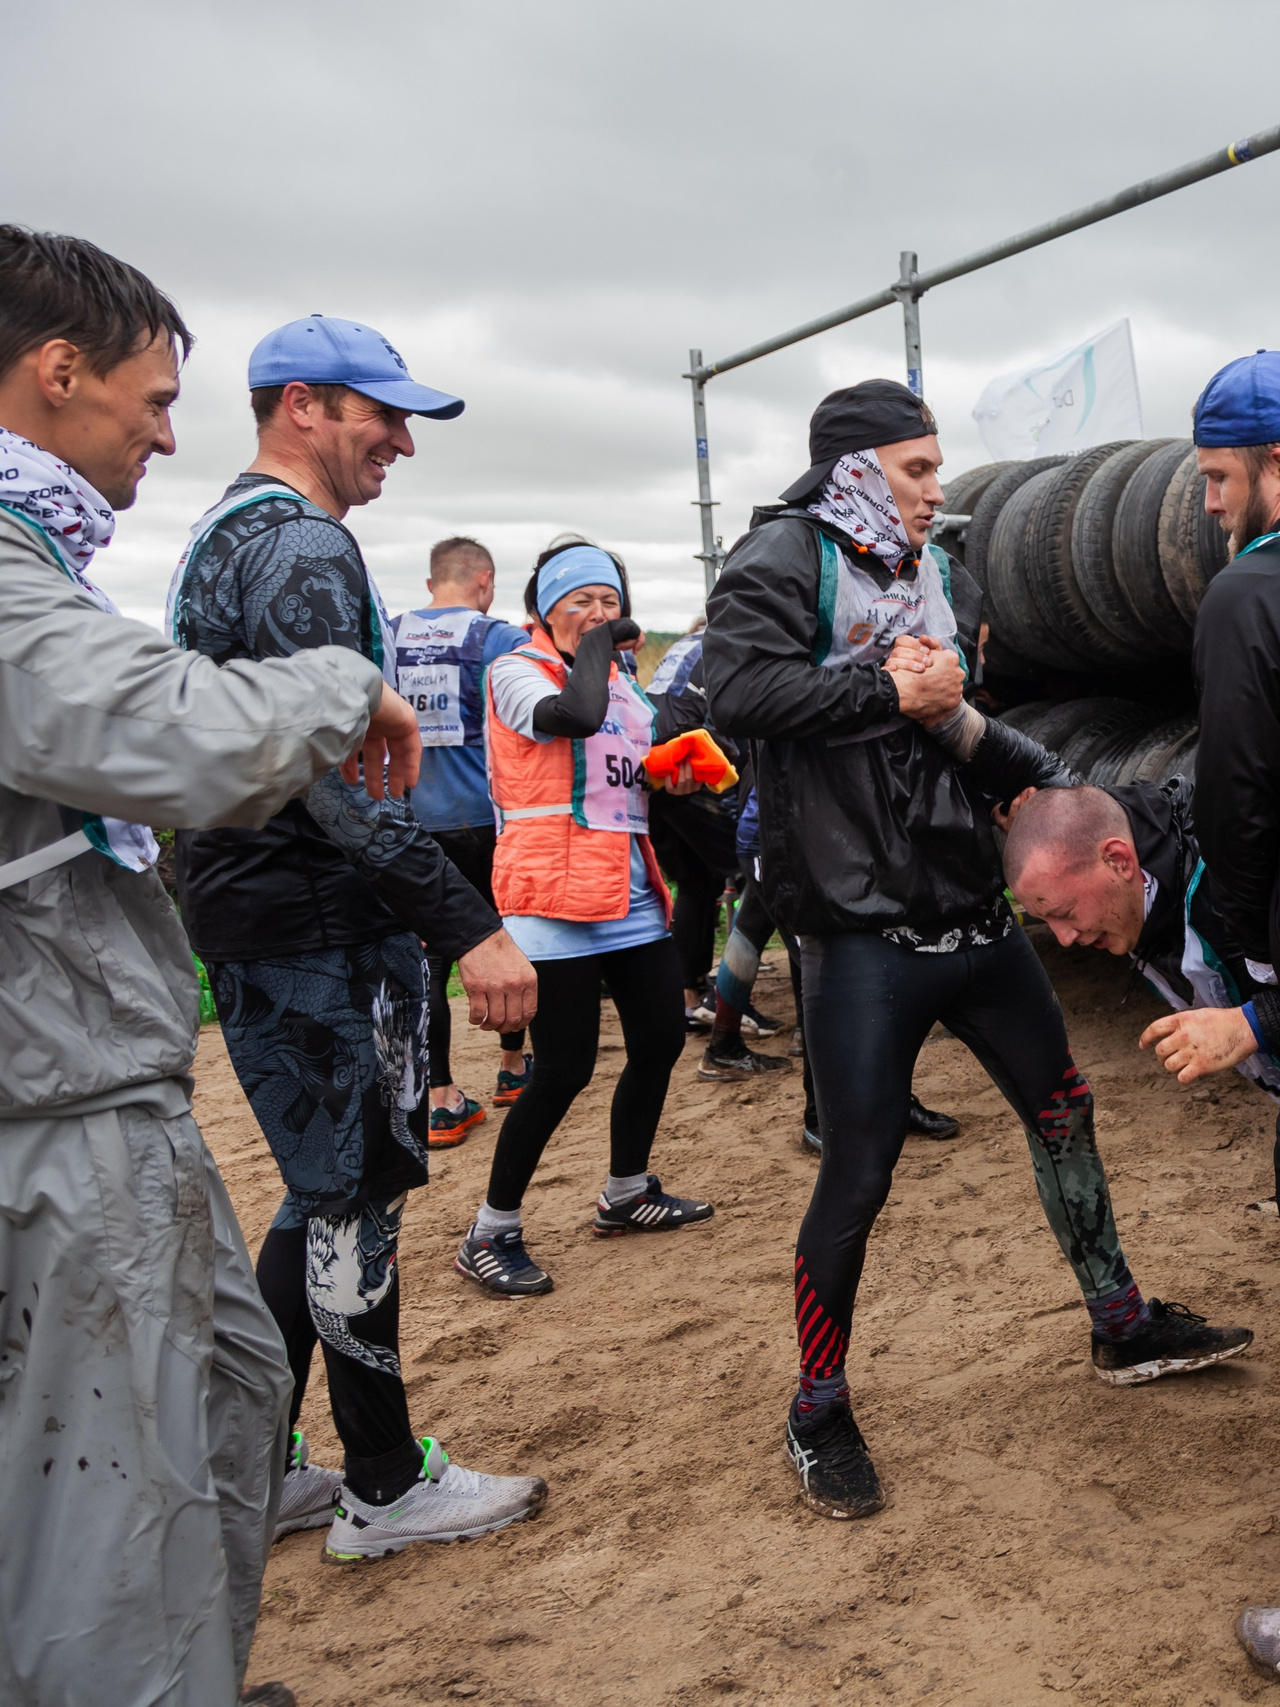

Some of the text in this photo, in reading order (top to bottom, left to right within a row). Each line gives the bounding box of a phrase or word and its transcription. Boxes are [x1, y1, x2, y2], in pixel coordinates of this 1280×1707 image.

[848, 484, 889, 518] TORERO
[401, 693, 449, 712] 1610
[605, 753, 650, 793] 504
